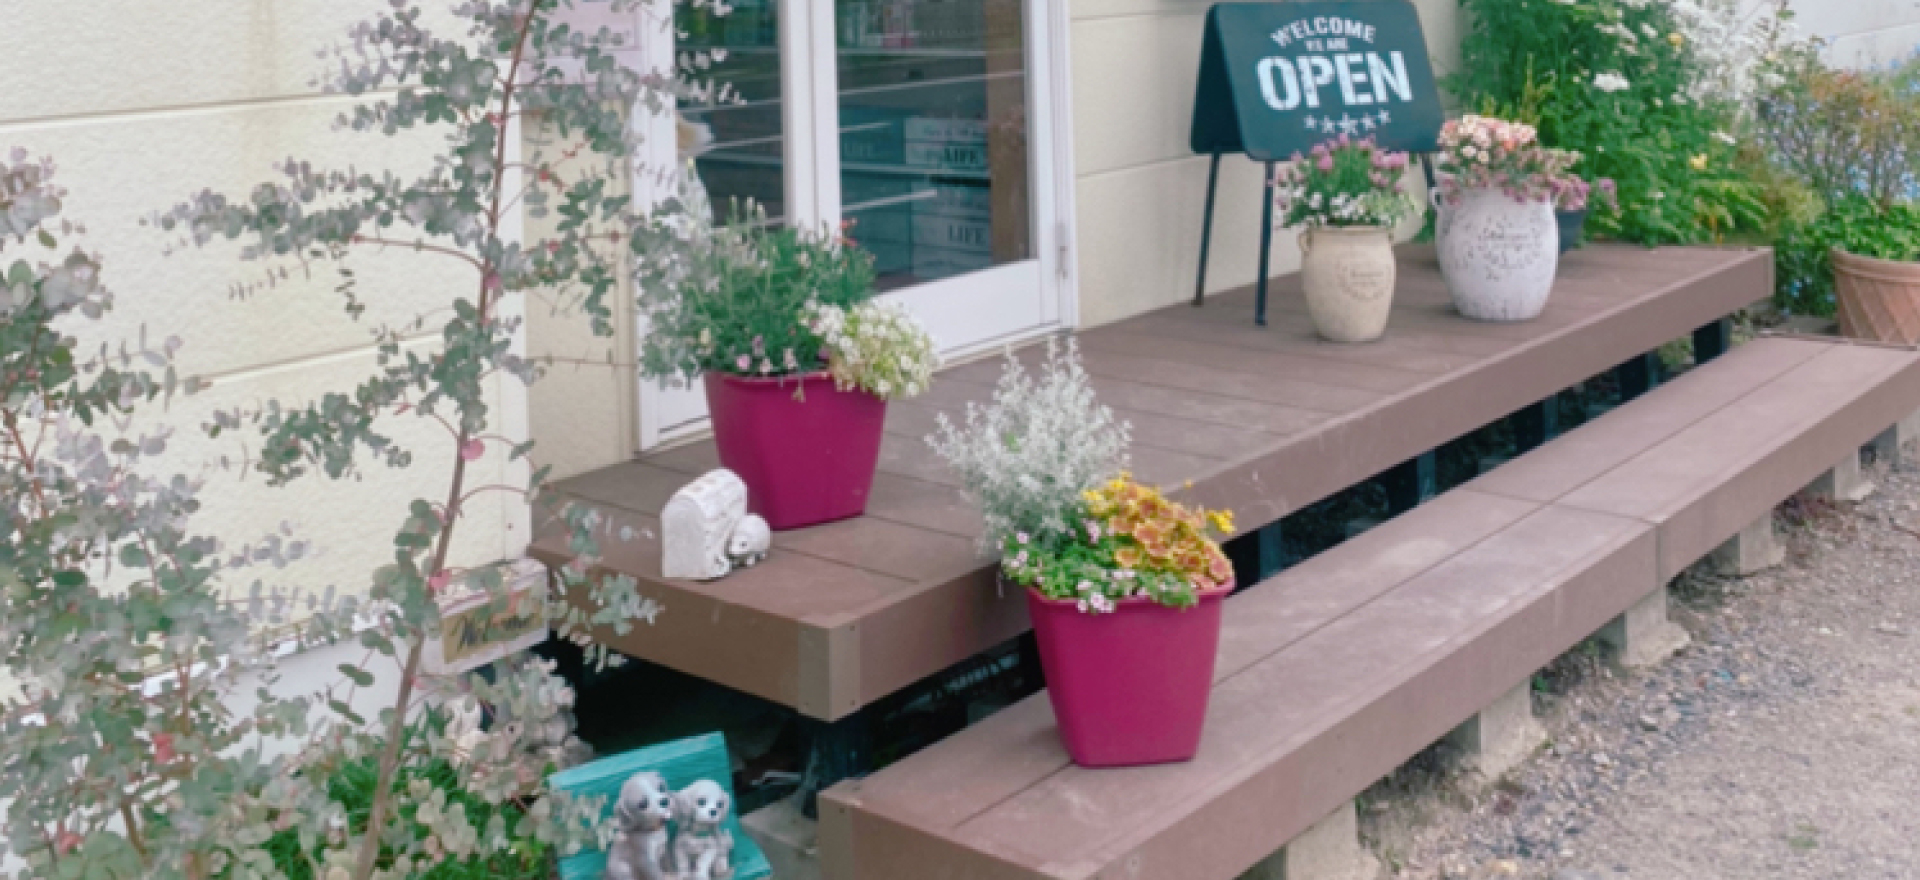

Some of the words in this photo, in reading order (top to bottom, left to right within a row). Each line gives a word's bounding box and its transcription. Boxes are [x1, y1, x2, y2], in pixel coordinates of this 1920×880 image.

[1270, 15, 1376, 48] WELCOME
[1257, 51, 1412, 110] OPEN
[944, 147, 979, 164] LIFE
[948, 223, 986, 246] LIFE
